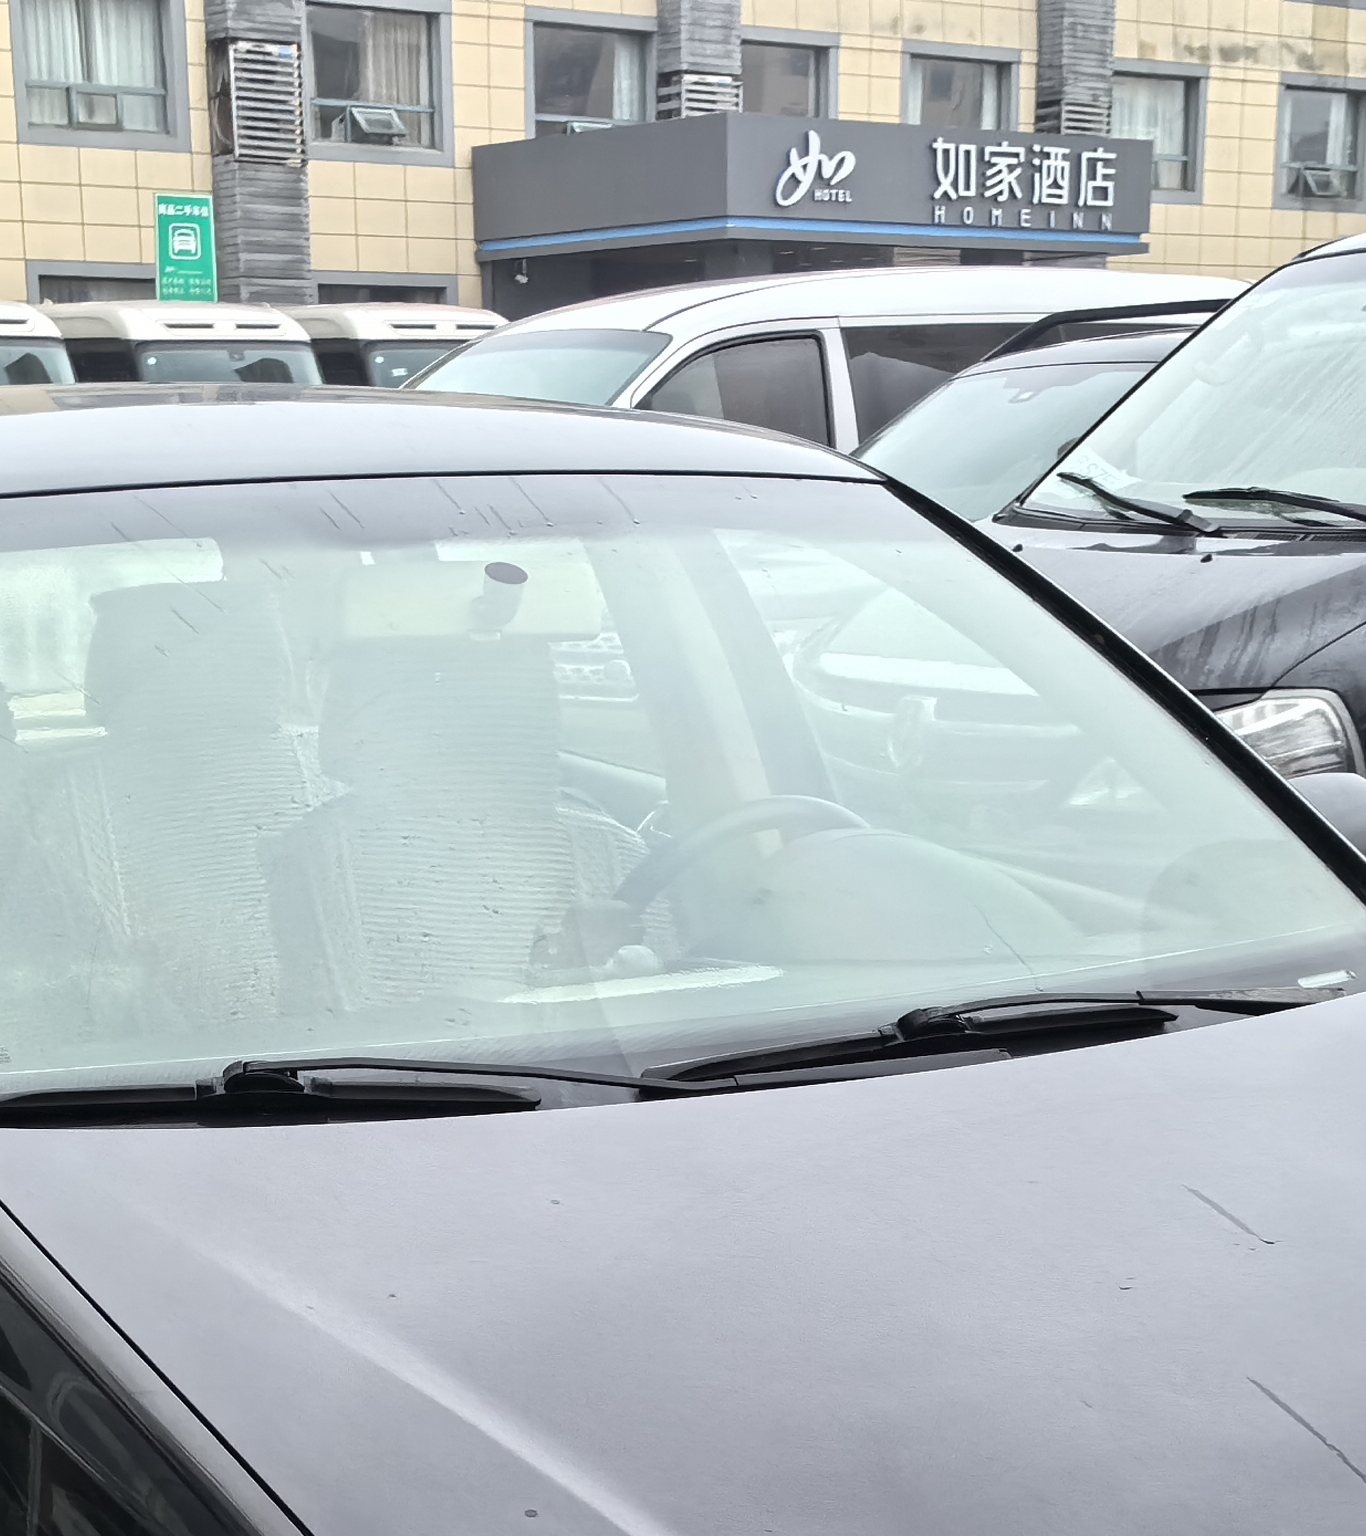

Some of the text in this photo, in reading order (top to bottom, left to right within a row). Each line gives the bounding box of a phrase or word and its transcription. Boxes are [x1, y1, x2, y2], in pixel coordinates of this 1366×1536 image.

[932, 137, 1118, 207] 如家酒店
[814, 188, 853, 203] HOTEL
